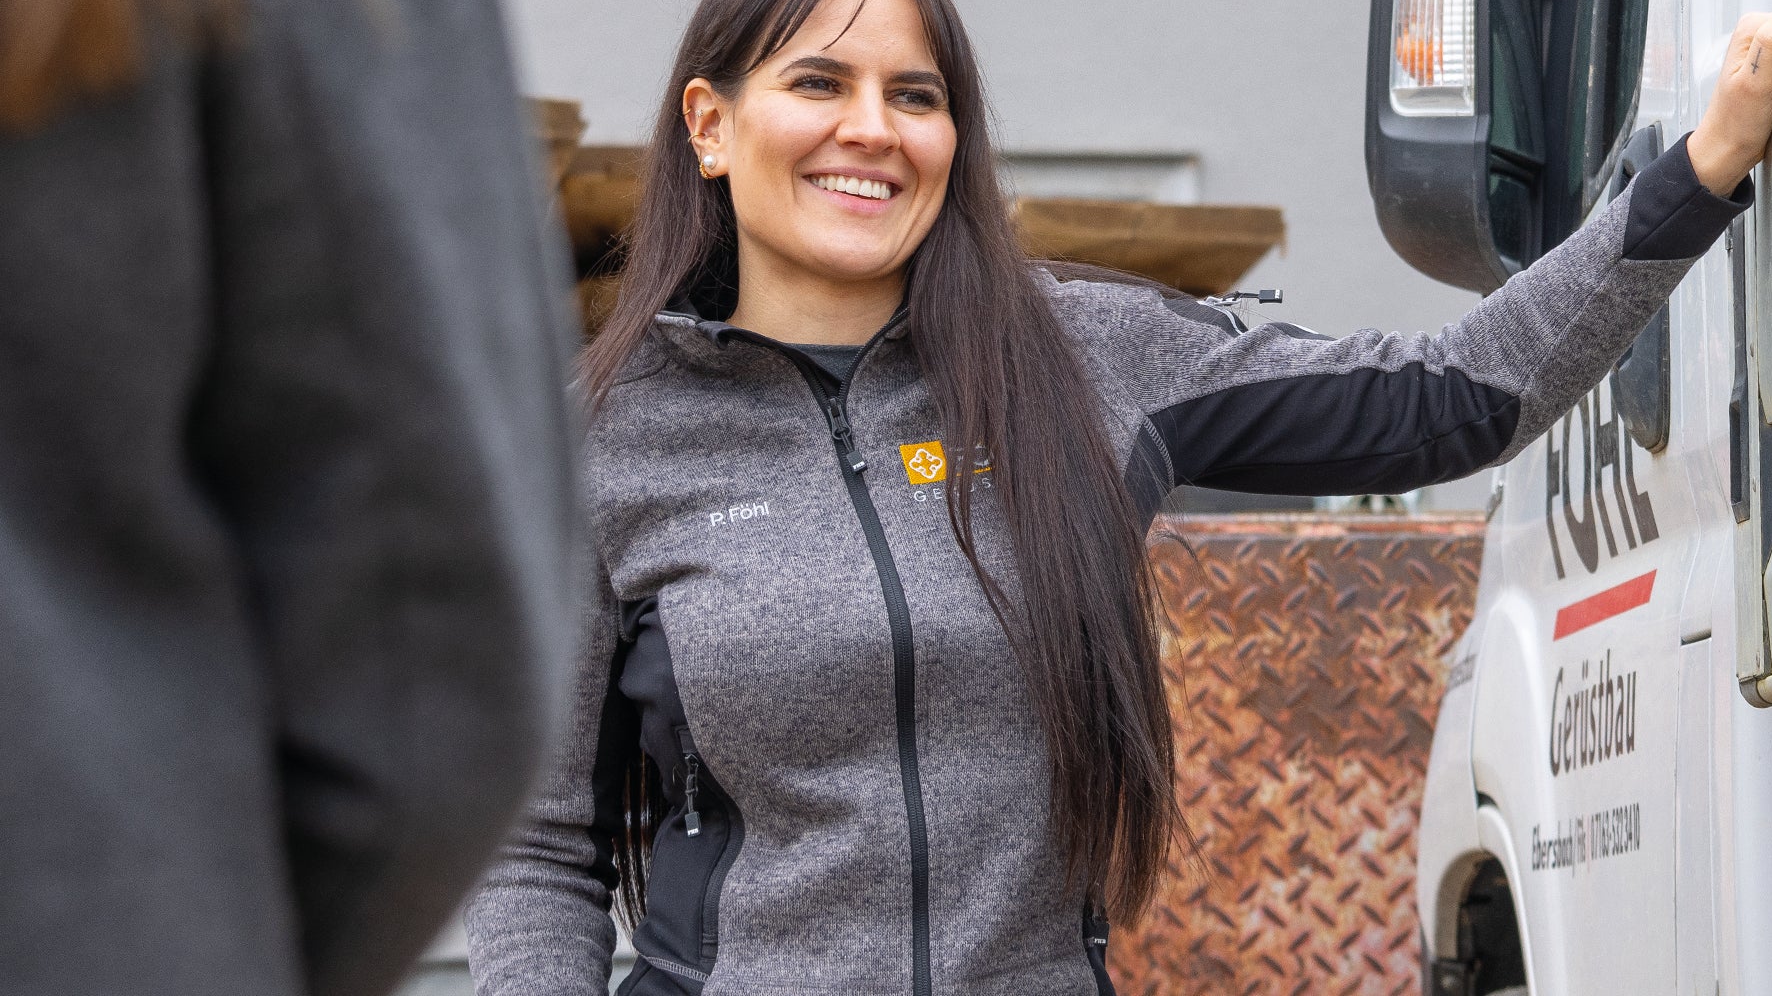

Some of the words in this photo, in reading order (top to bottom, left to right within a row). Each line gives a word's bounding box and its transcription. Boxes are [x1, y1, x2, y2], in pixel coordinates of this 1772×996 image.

[710, 512, 726, 526] P.
[729, 501, 769, 522] Föhl
[1550, 648, 1637, 777] Gerüstbau
